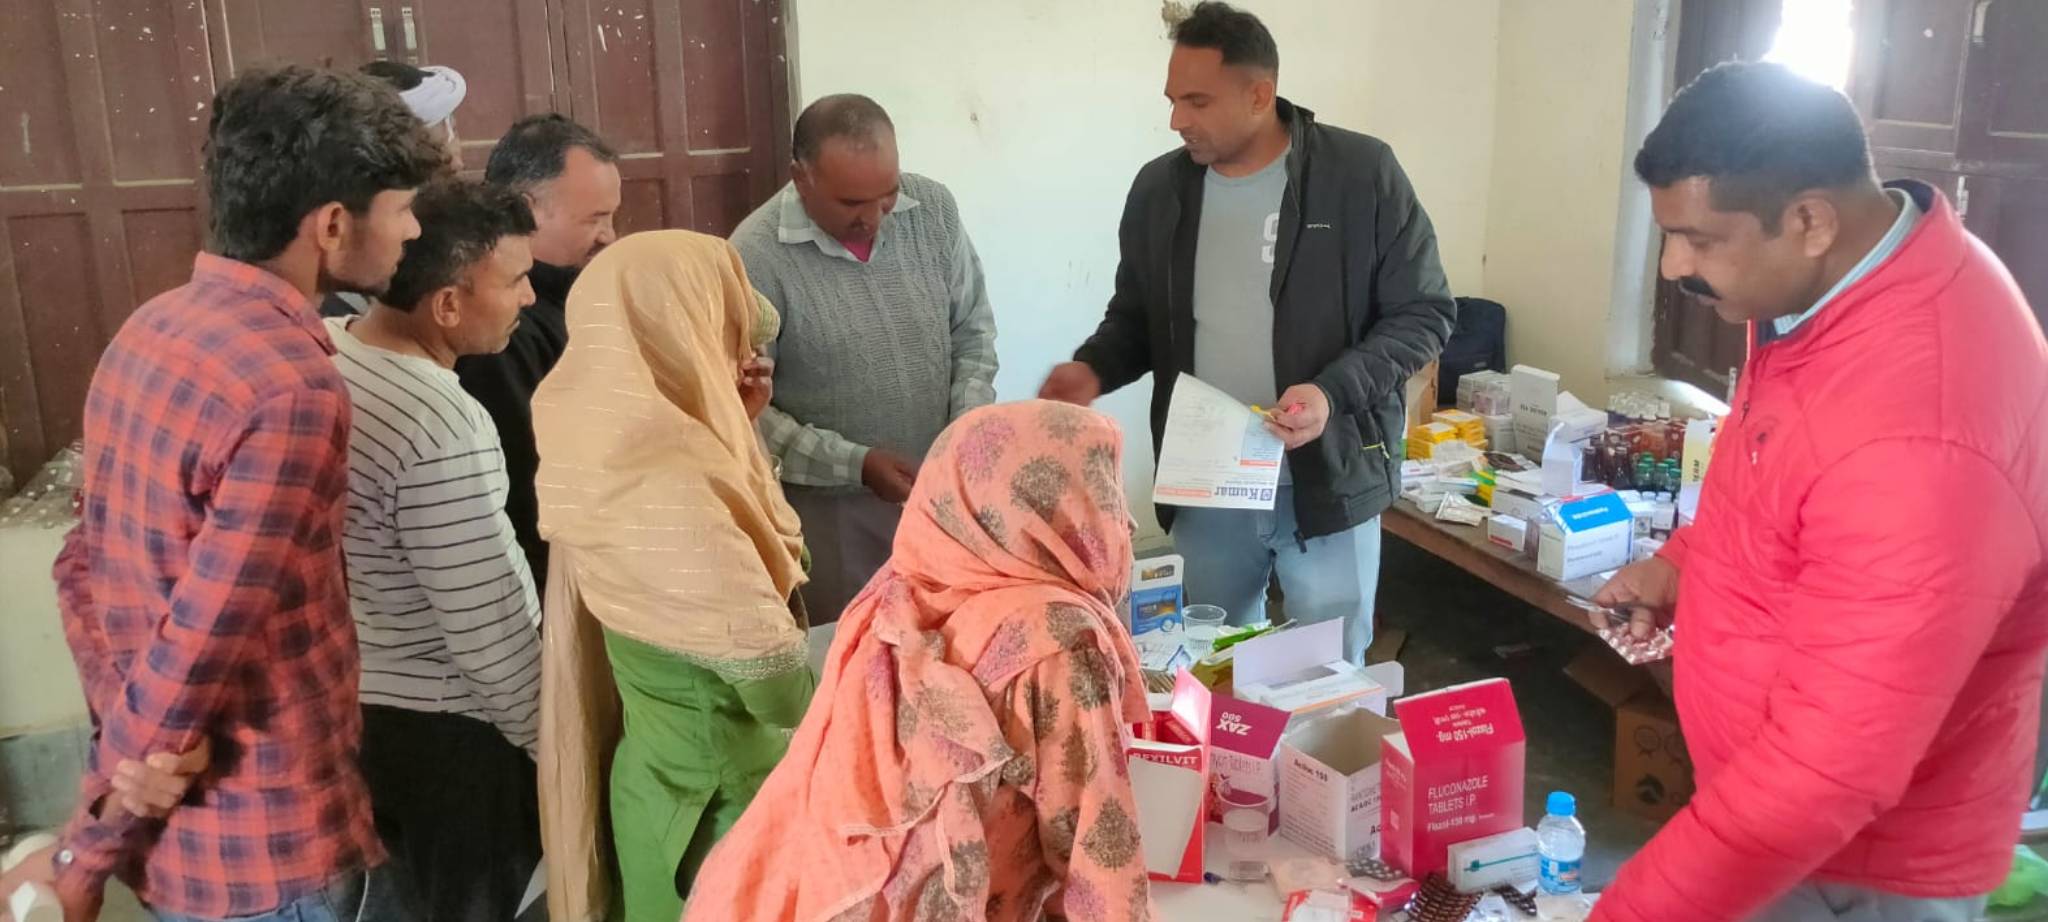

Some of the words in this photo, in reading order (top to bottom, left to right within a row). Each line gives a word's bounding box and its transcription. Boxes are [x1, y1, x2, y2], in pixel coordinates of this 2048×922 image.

[1214, 486, 1258, 500] Kumar
[1215, 718, 1252, 736] ZAX
[1427, 775, 1489, 800] FLUCONAZOLE
[1428, 796, 1465, 815] TABLETS
